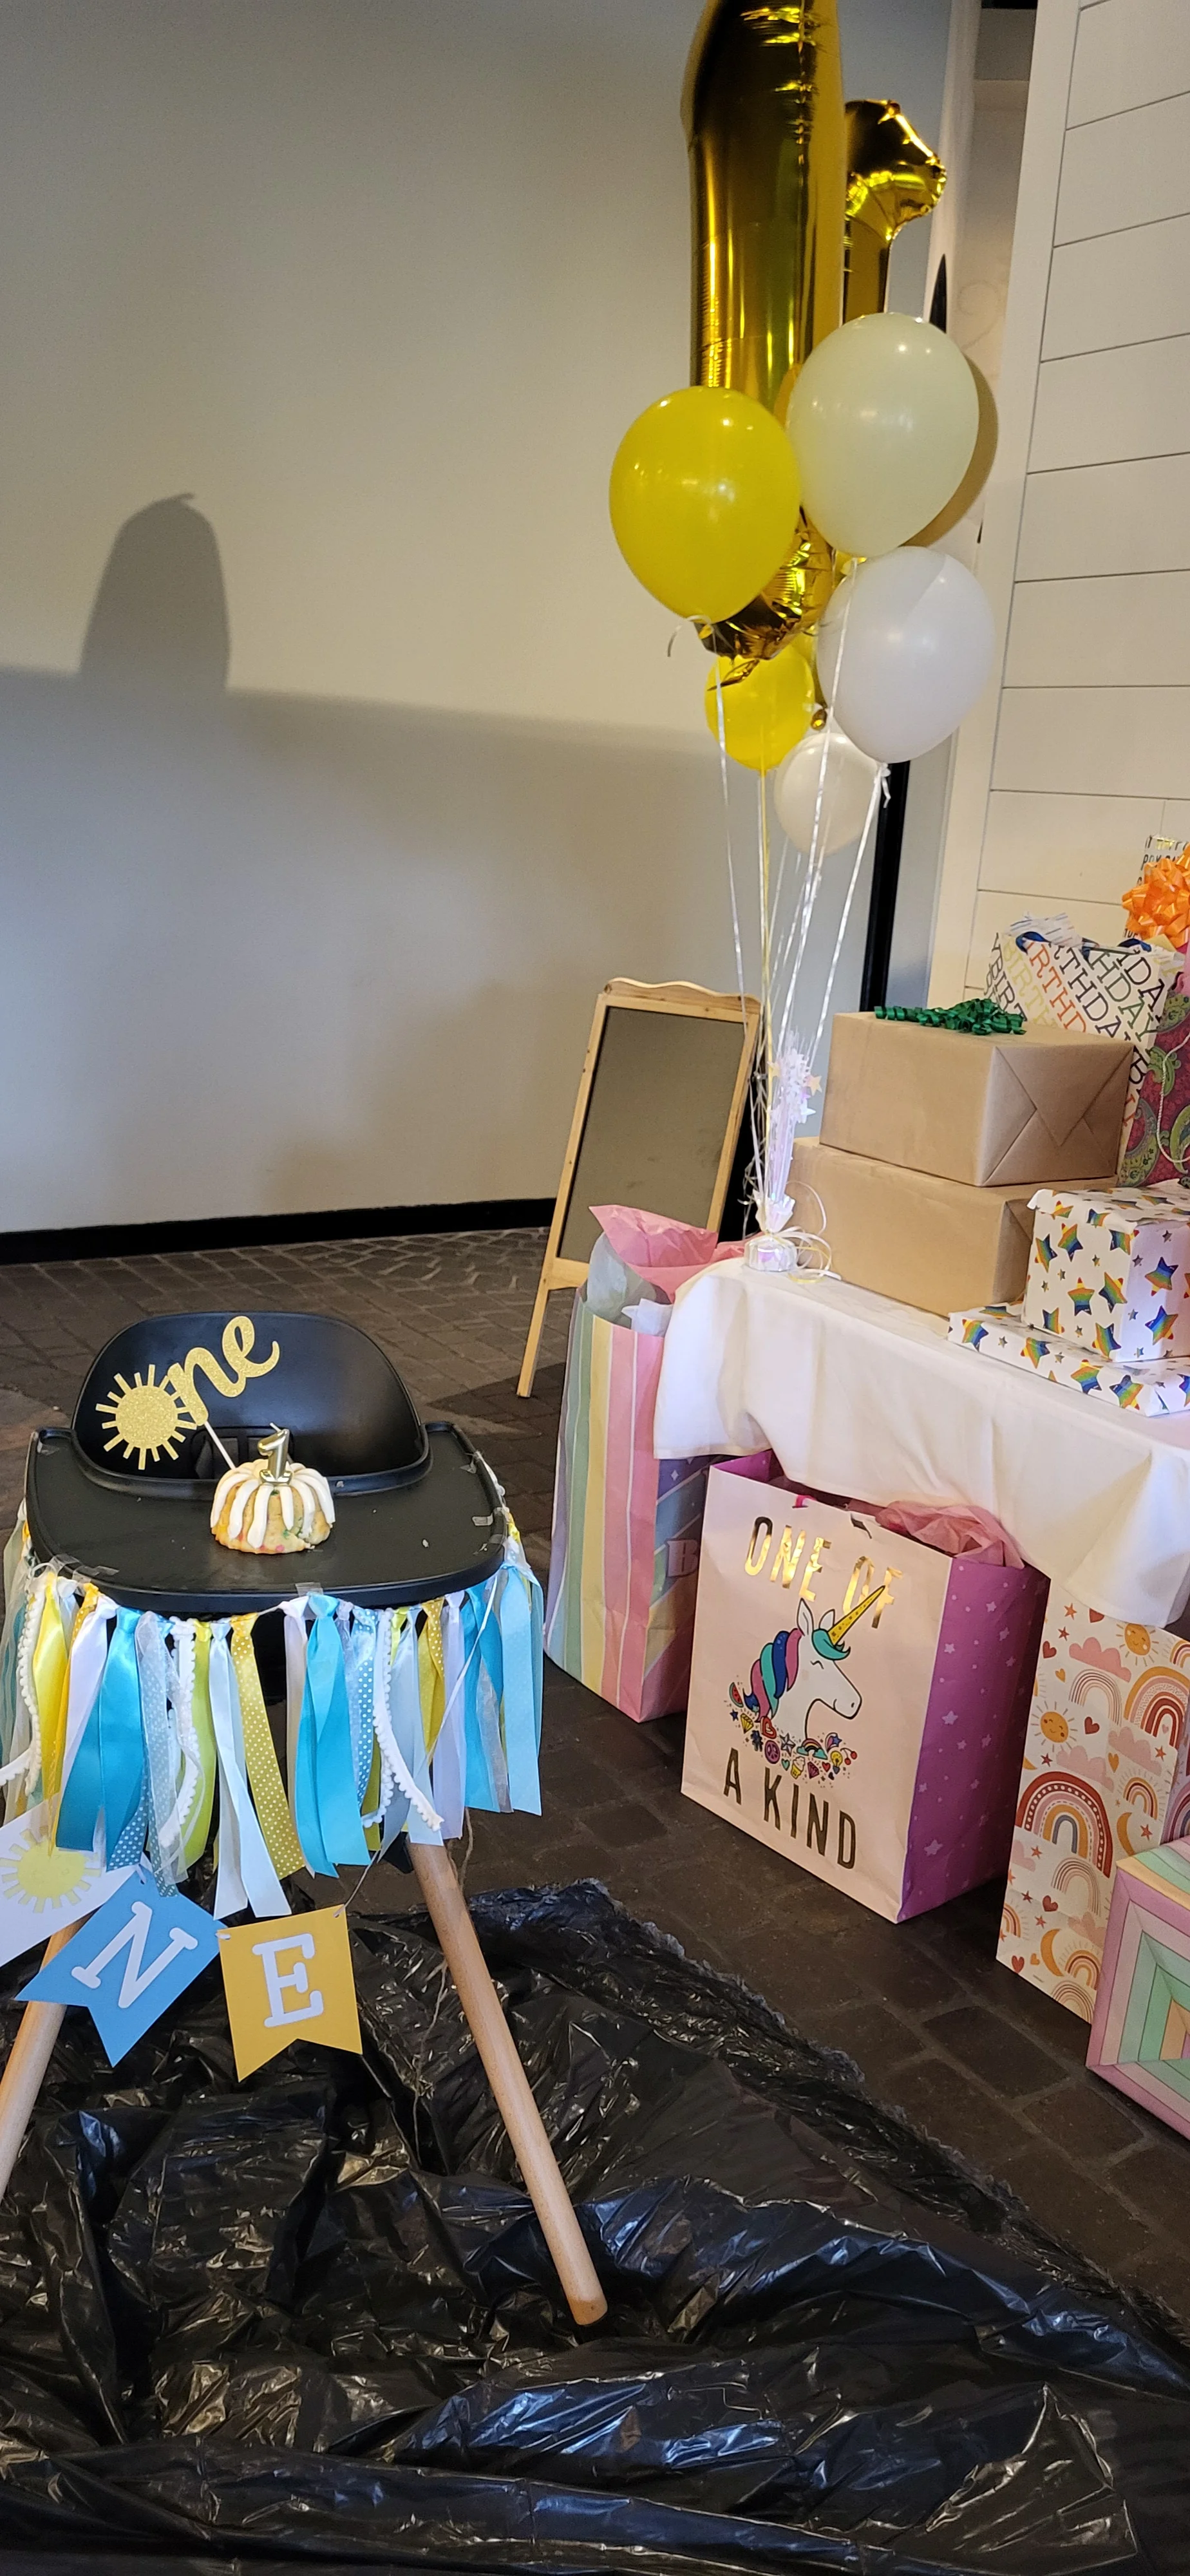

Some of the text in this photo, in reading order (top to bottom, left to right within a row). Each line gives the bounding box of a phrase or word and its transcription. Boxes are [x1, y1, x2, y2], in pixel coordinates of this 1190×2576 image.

[744, 1516, 903, 1629] ONE OF
[723, 1747, 856, 1870] A KIND
